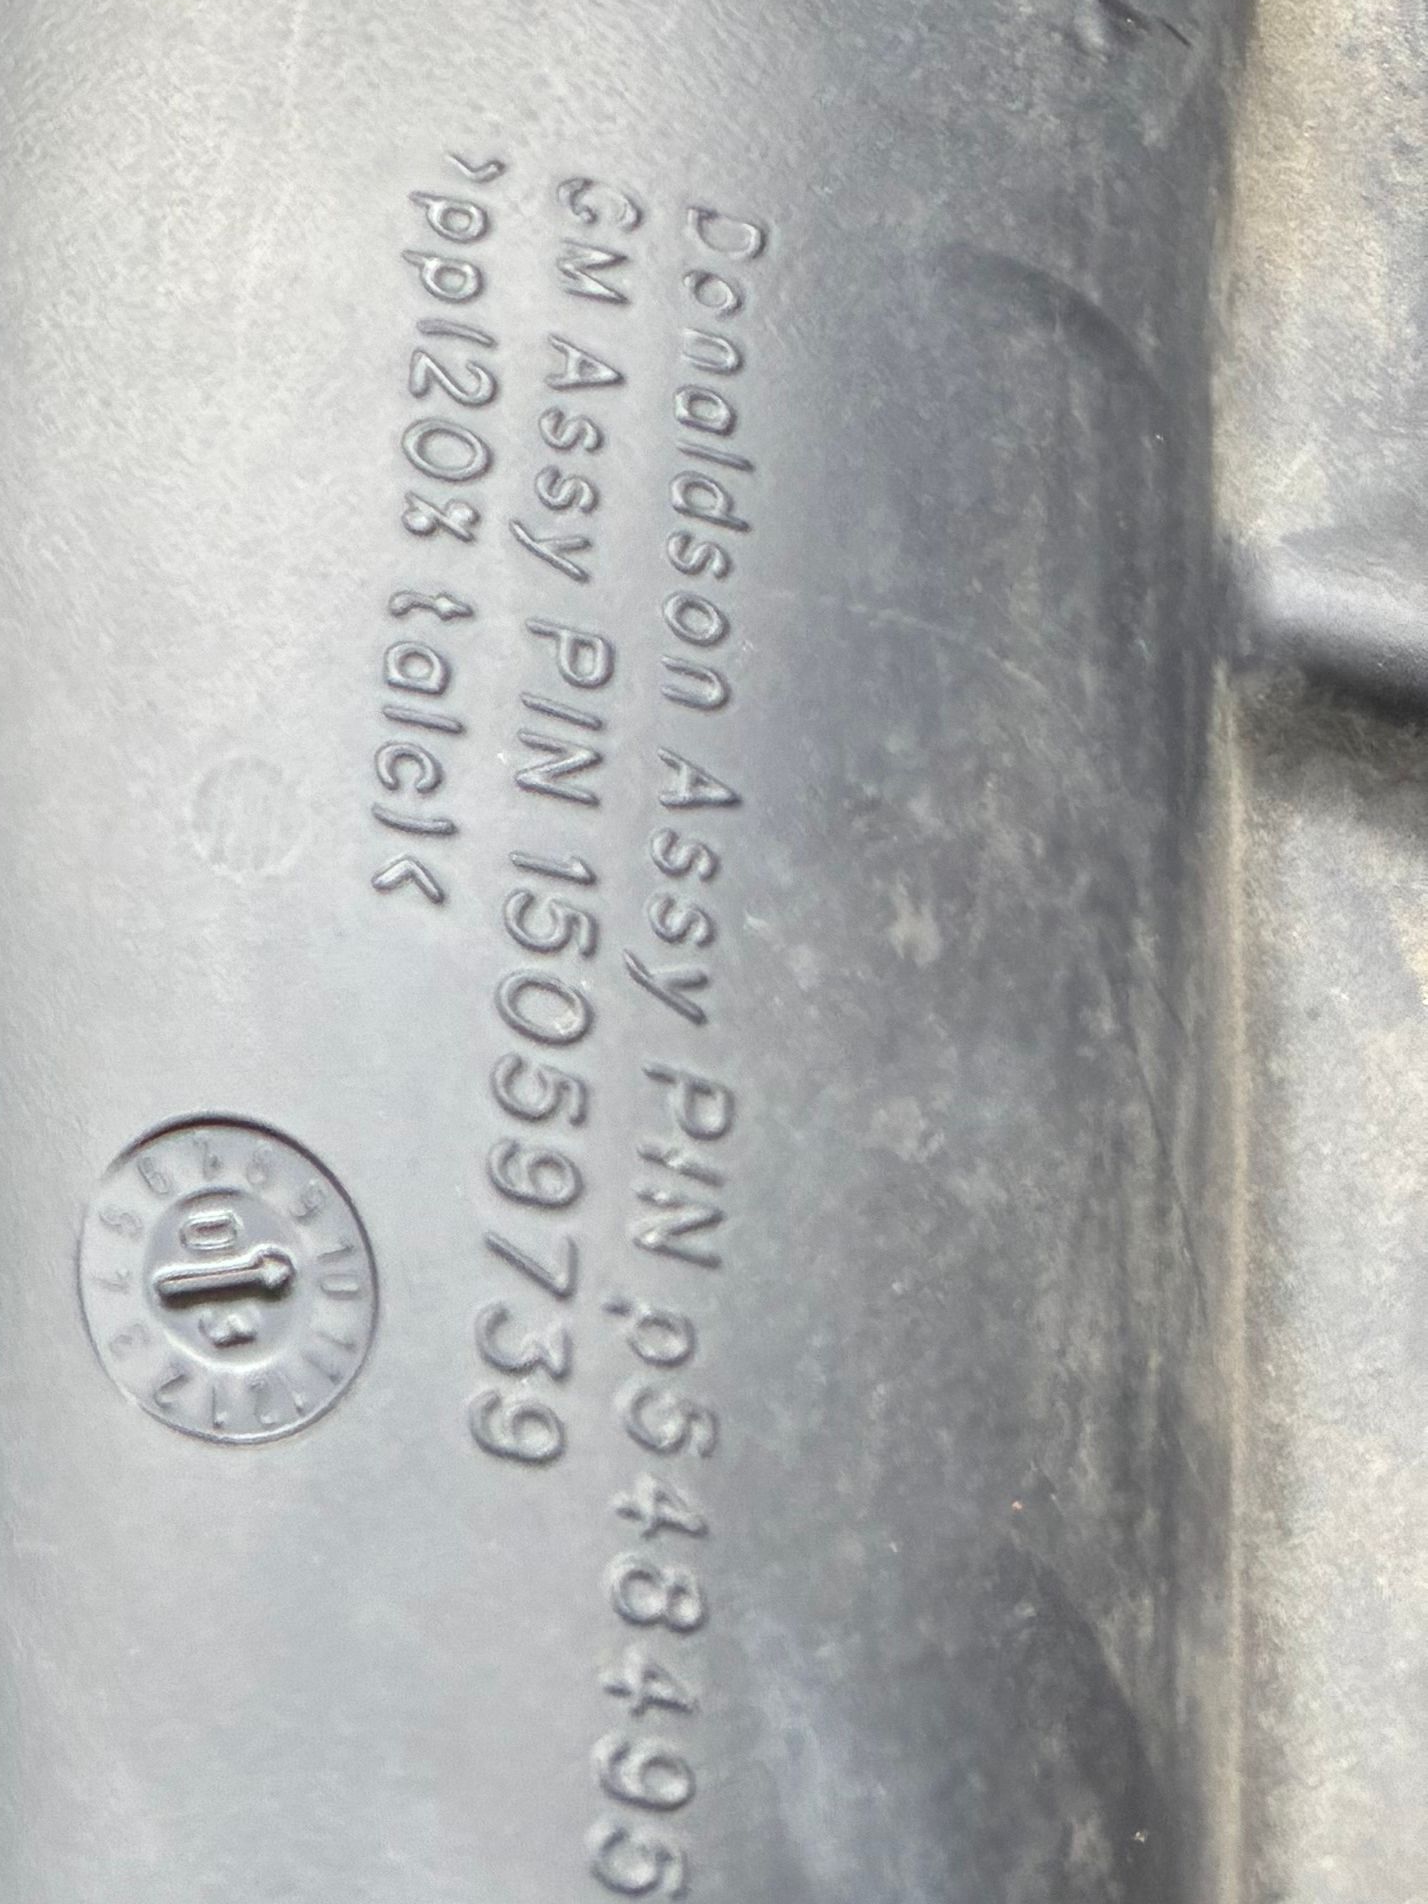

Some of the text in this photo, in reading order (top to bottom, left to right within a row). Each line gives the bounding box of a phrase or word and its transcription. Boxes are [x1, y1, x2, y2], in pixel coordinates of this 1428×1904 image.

[554, 176, 643, 305] GM
[506, 332, 625, 584] Assy
[659, 204, 768, 712] Donaldson
[622, 746, 744, 1025] Assy
[468, 851, 598, 1466] 15059739
